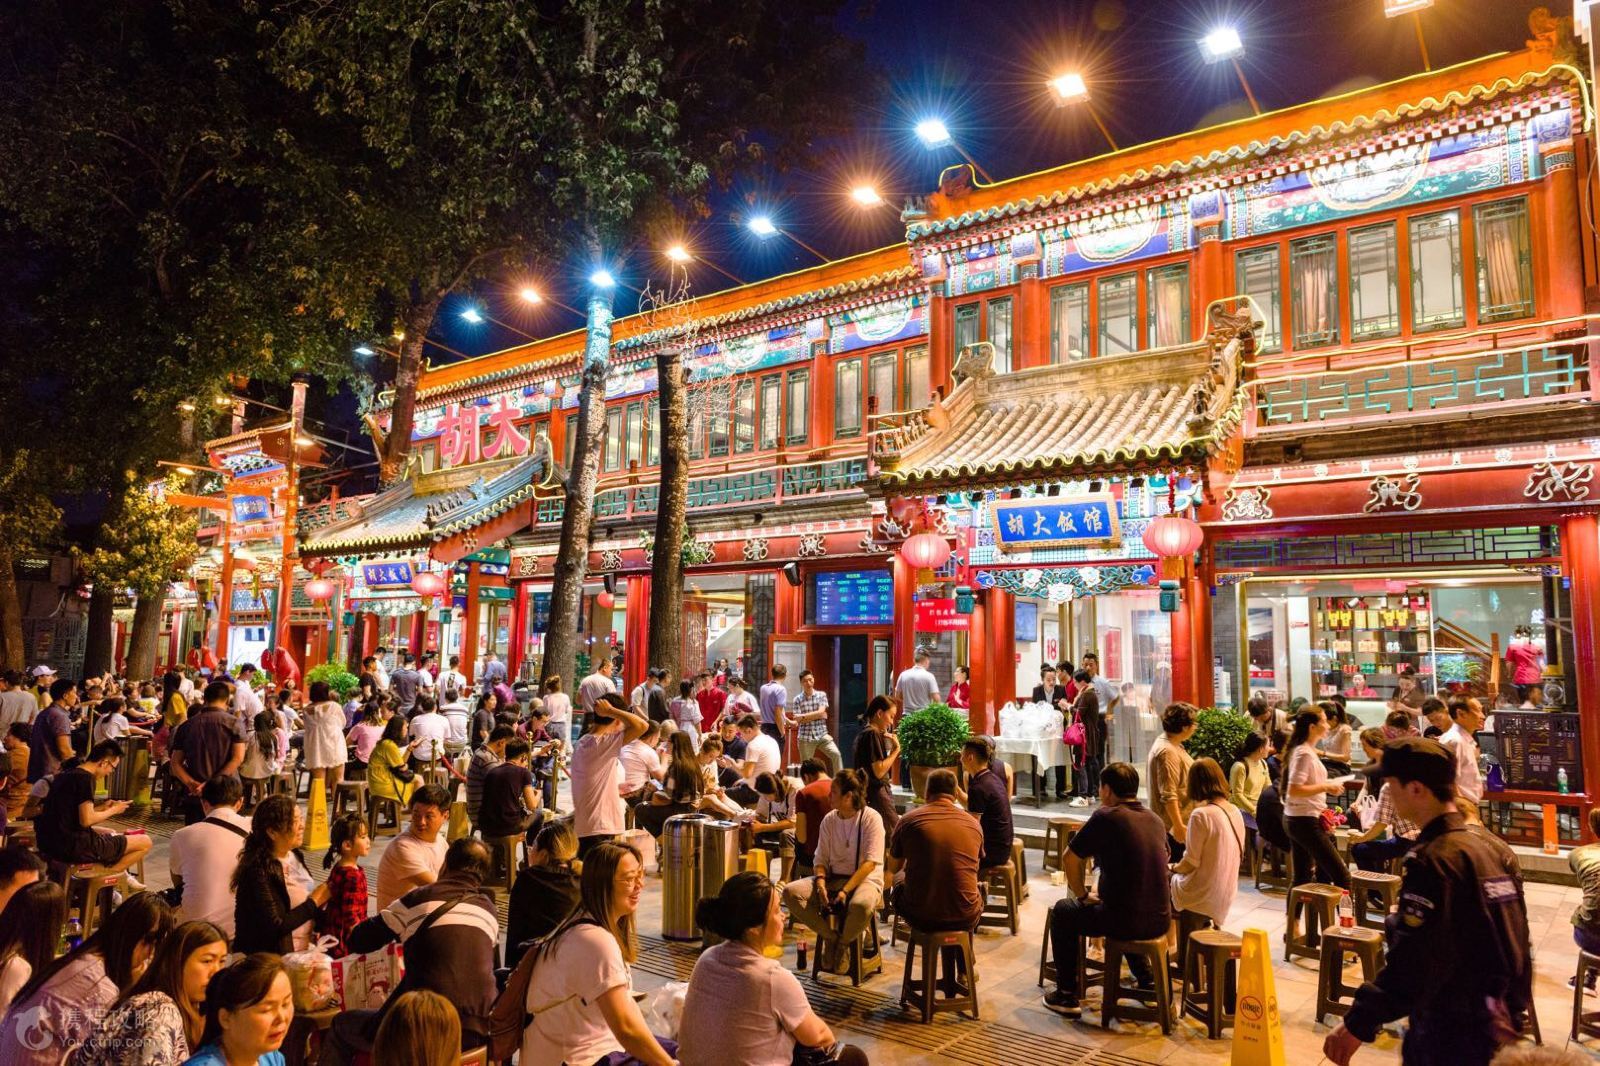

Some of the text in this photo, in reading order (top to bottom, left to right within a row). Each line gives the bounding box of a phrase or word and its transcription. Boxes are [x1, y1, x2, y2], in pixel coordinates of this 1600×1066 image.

[435, 395, 530, 465] 胡大
[1007, 506, 1102, 536] 胡大饭馆
[1047, 639, 1057, 660] 18
